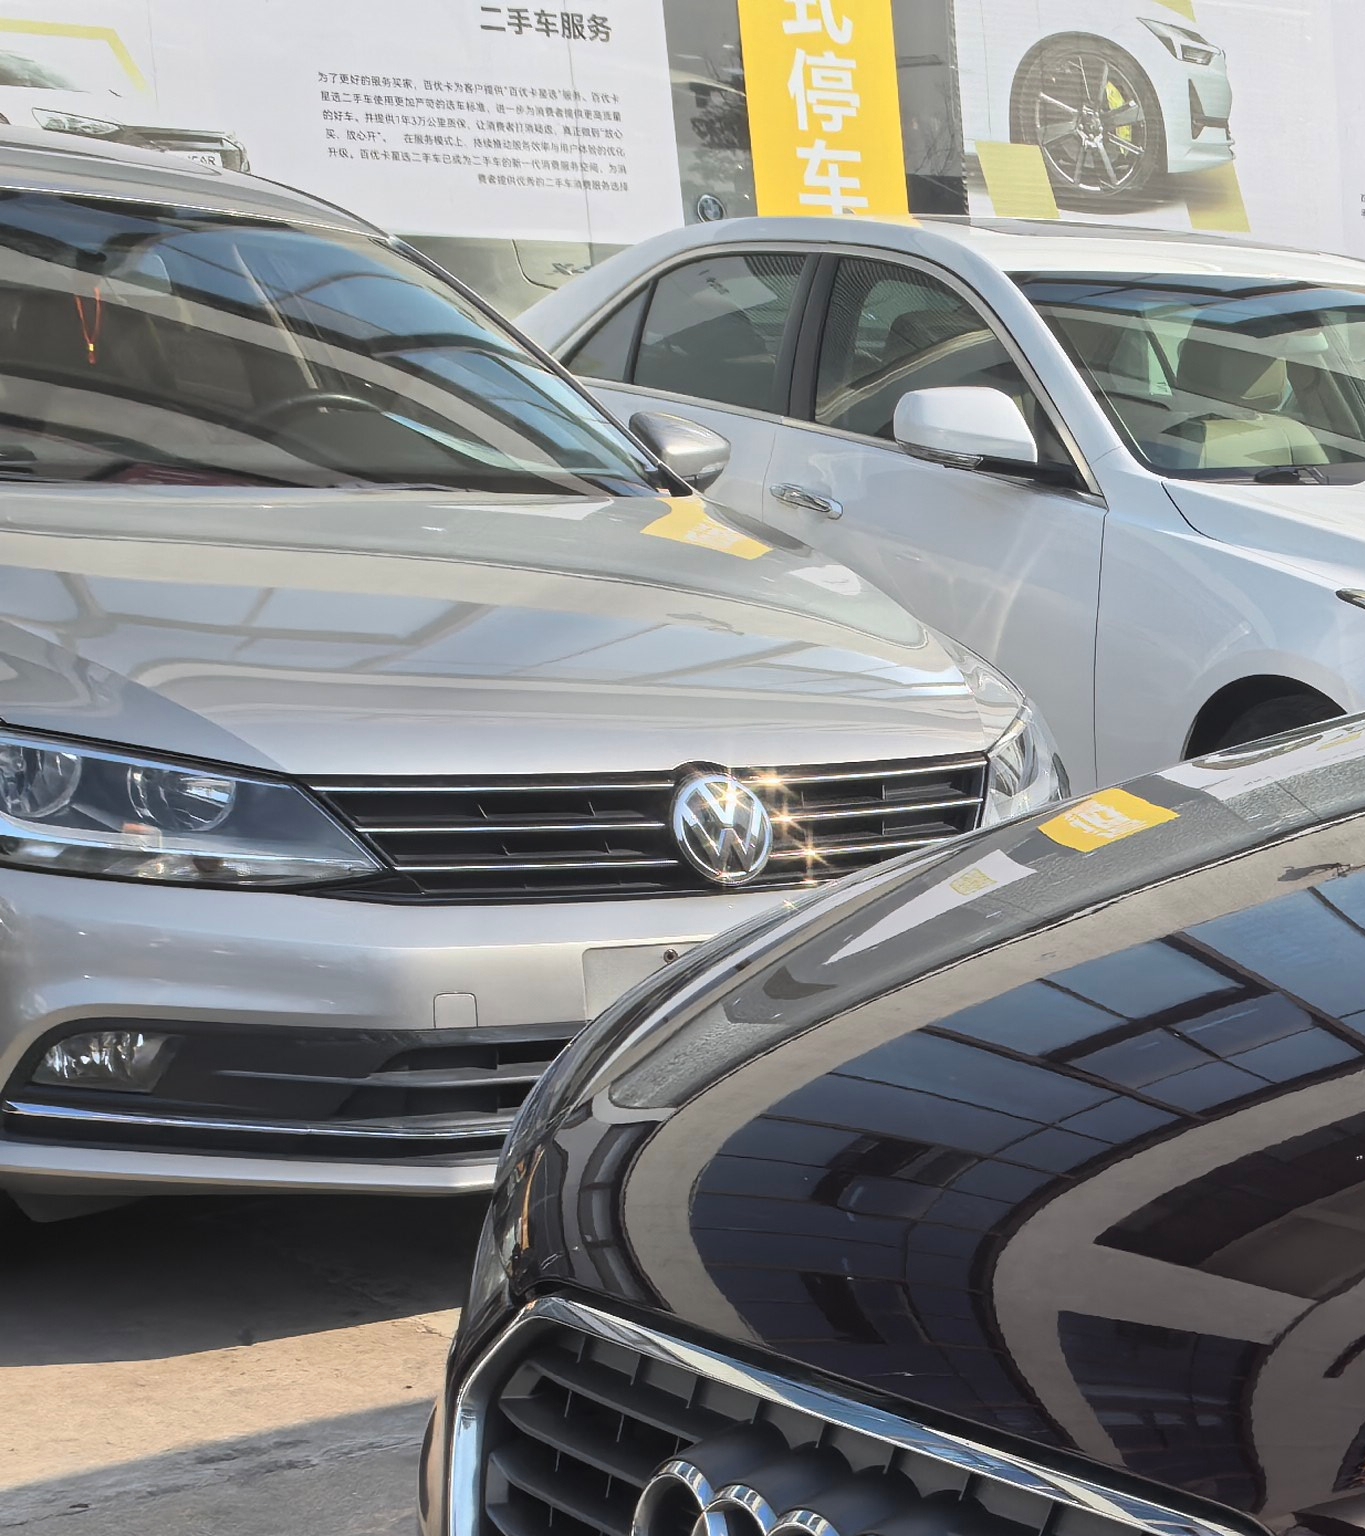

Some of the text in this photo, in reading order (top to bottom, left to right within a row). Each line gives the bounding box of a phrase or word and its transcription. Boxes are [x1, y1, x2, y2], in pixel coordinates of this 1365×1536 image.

[480, 6, 612, 42] 二手车服务
